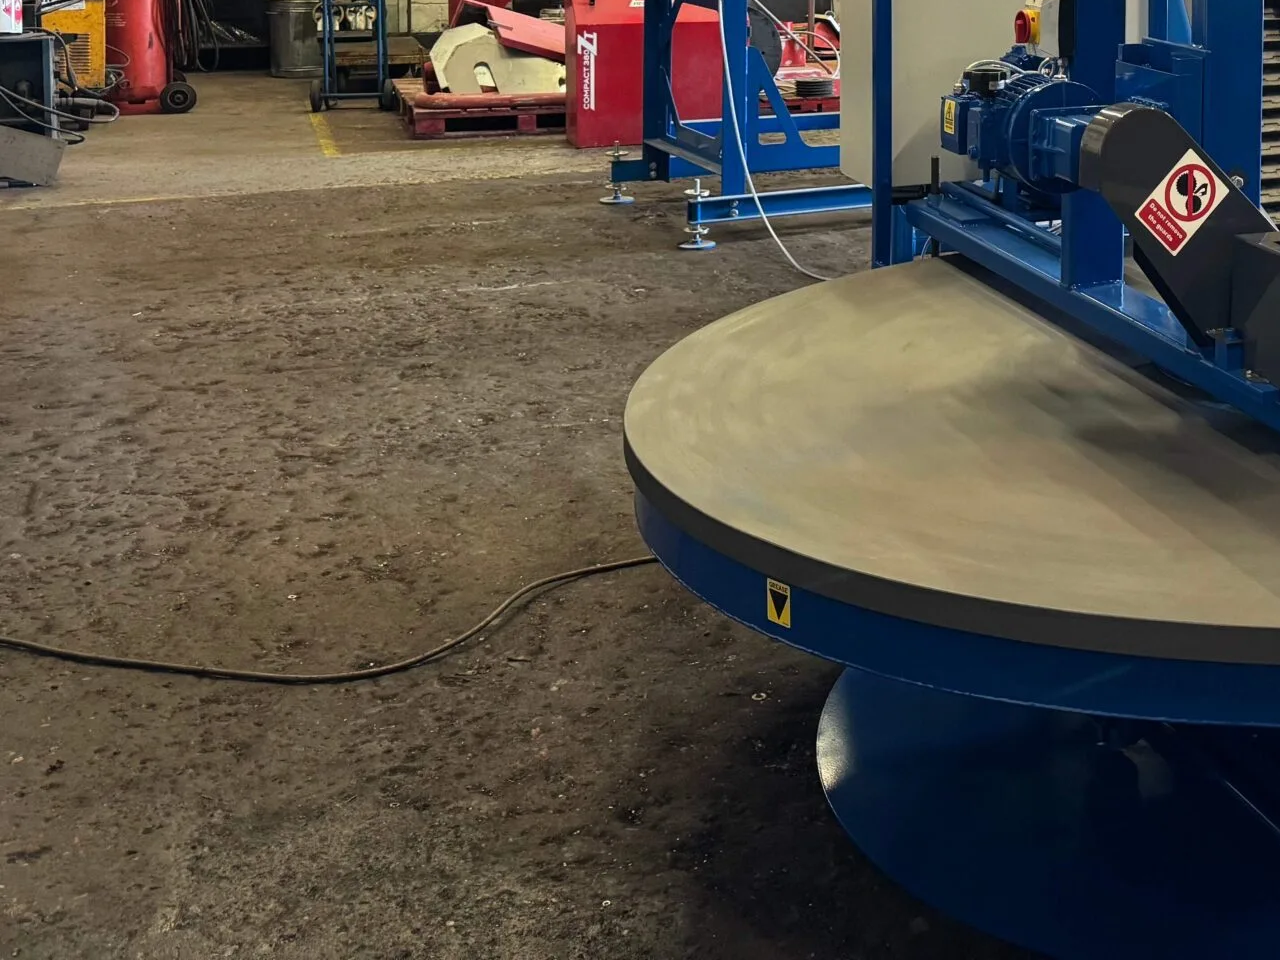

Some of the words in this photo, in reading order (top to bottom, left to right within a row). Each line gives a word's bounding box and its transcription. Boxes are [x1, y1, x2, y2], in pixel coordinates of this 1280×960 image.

[1147, 214, 1157, 224] the
[1155, 223, 1173, 242] guards
[1149, 203, 1157, 212] Do
[1156, 210, 1166, 221] not
[1165, 220, 1183, 239] remove
